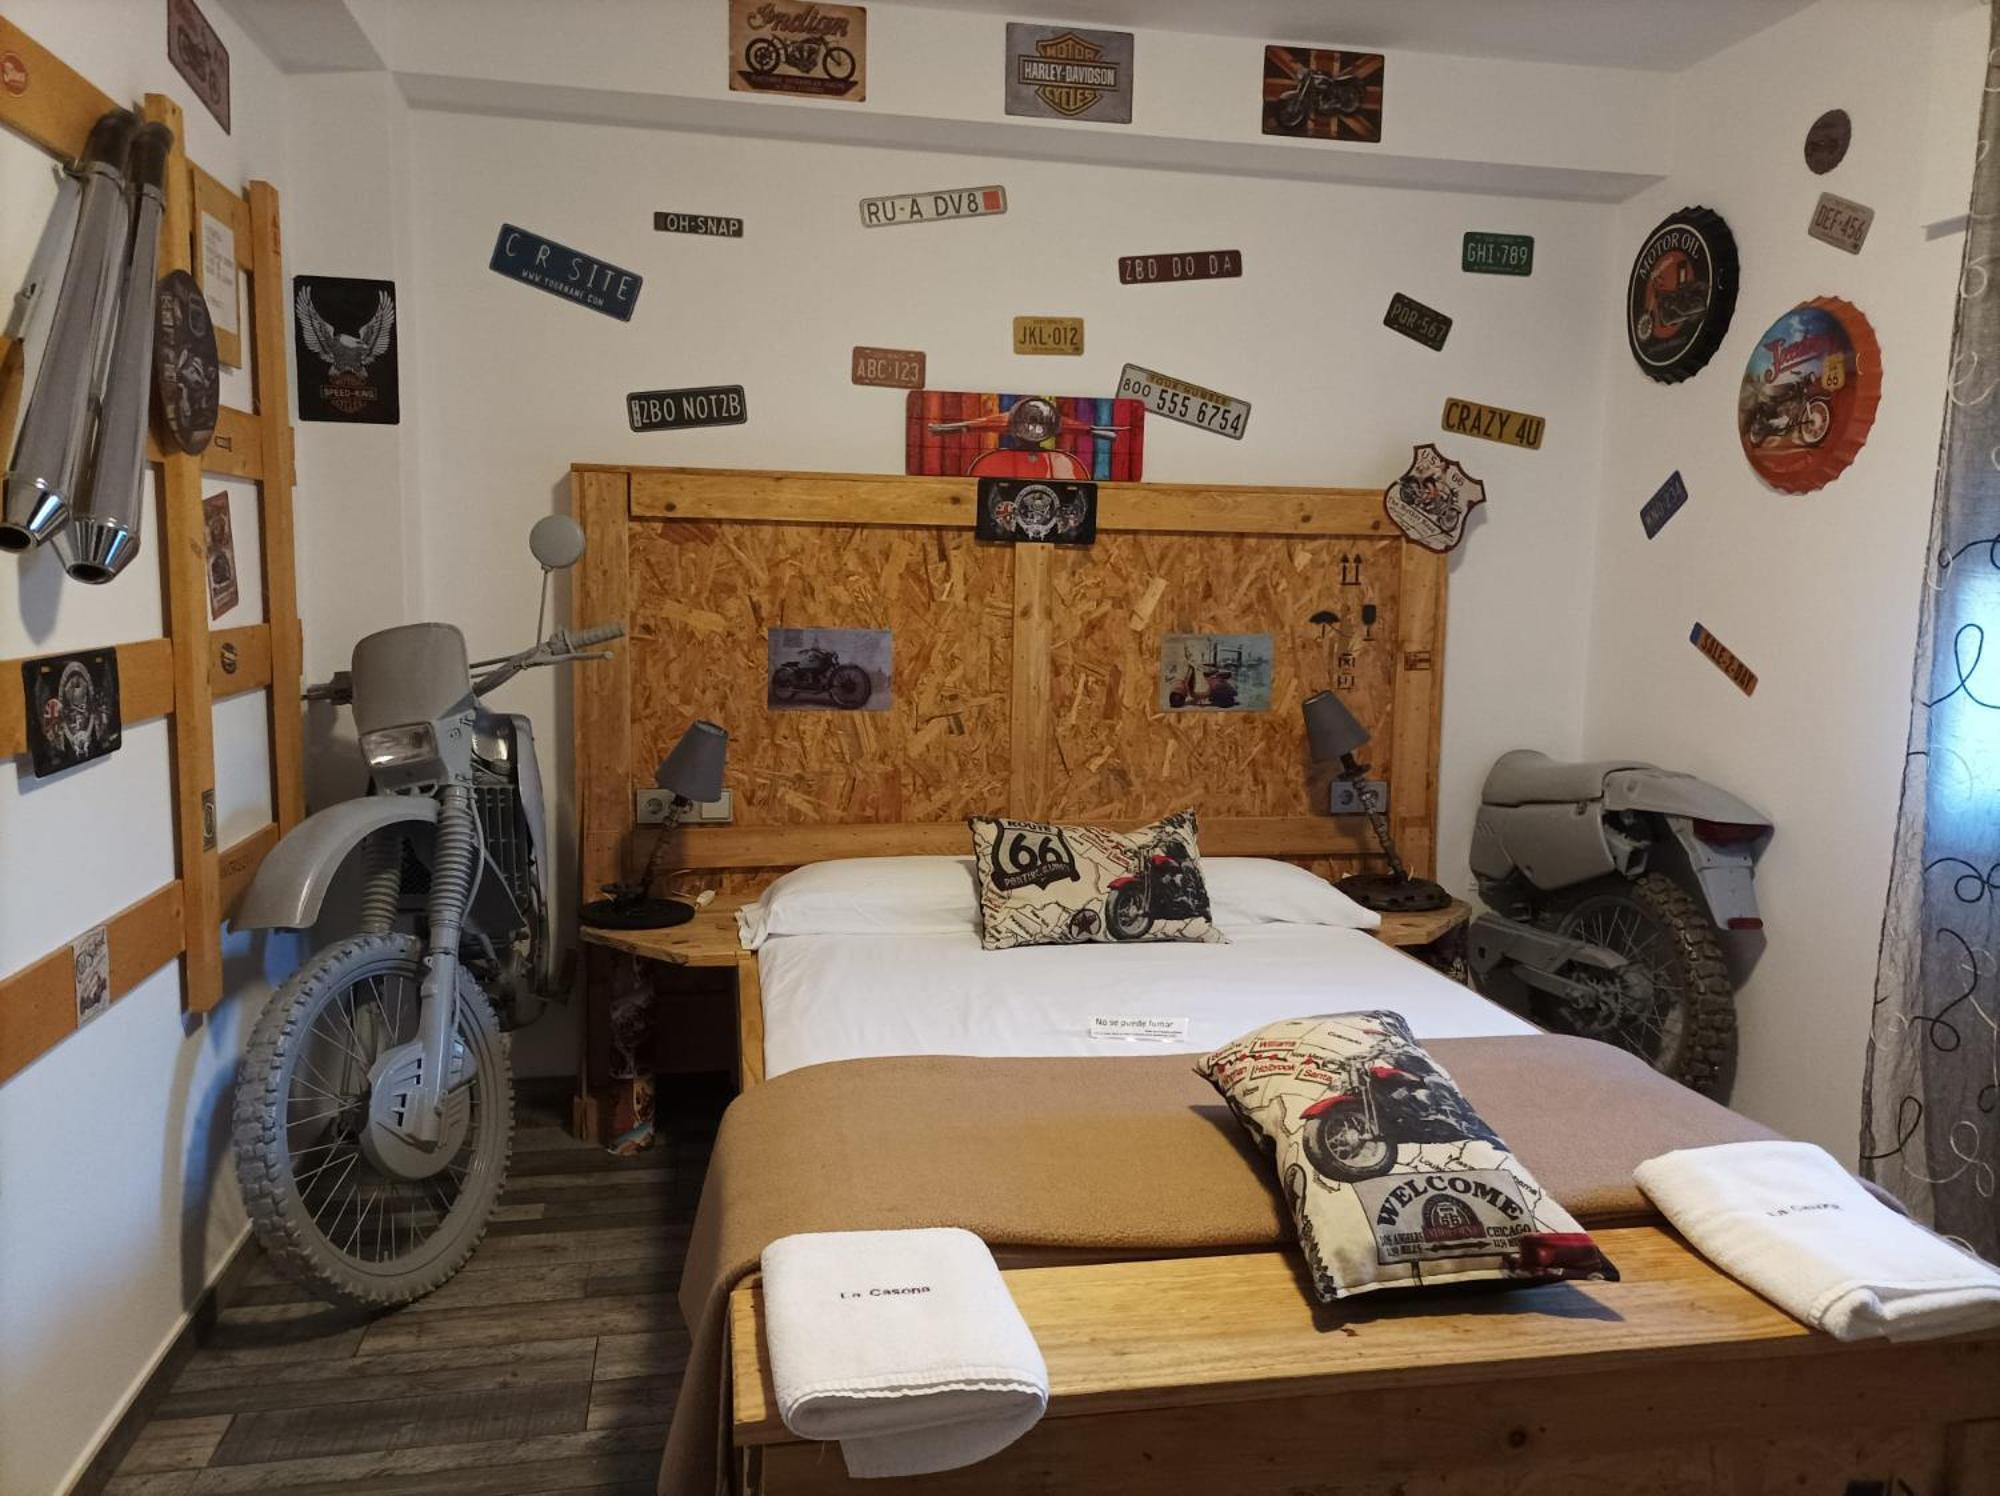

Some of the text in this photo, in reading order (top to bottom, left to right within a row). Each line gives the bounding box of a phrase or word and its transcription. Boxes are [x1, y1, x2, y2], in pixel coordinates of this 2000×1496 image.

[1024, 61, 1116, 86] HARLEY-DAVIDSON
[933, 192, 979, 217] DV8
[1638, 231, 1701, 280] MOTOR OIL
[567, 257, 632, 300] SITE
[1157, 388, 1191, 418] 555
[1196, 401, 1242, 434] 6754
[1445, 402, 1541, 446] CRAZY 4U
[1009, 833, 1064, 872] 66
[1377, 1175, 1524, 1226] WELCOME
[869, 1285, 931, 1297] Casona
